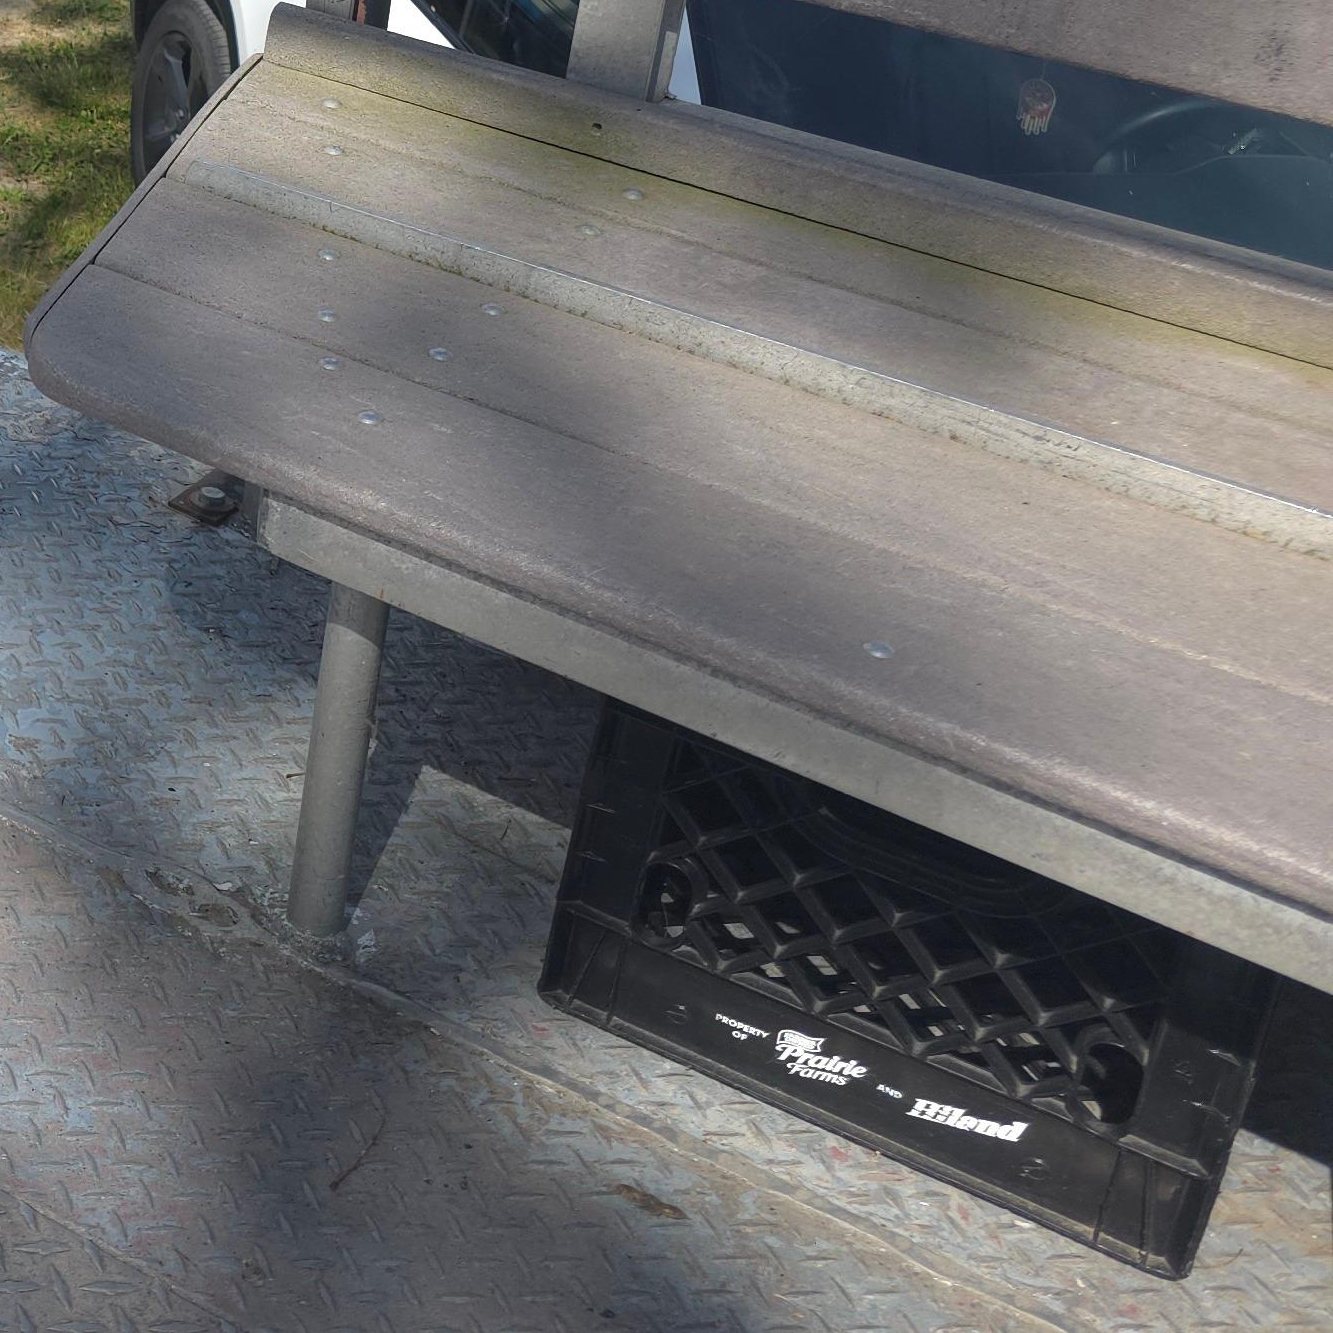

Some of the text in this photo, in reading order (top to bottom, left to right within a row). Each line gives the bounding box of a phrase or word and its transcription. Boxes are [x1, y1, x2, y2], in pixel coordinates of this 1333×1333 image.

[715, 1013, 770, 1038] PROPERTY
[732, 1030, 748, 1041] OF
[775, 1044, 868, 1078] Prairie
[786, 1062, 850, 1086] Farms
[876, 1084, 903, 1099] AND
[905, 1098, 1029, 1142] Hiland
